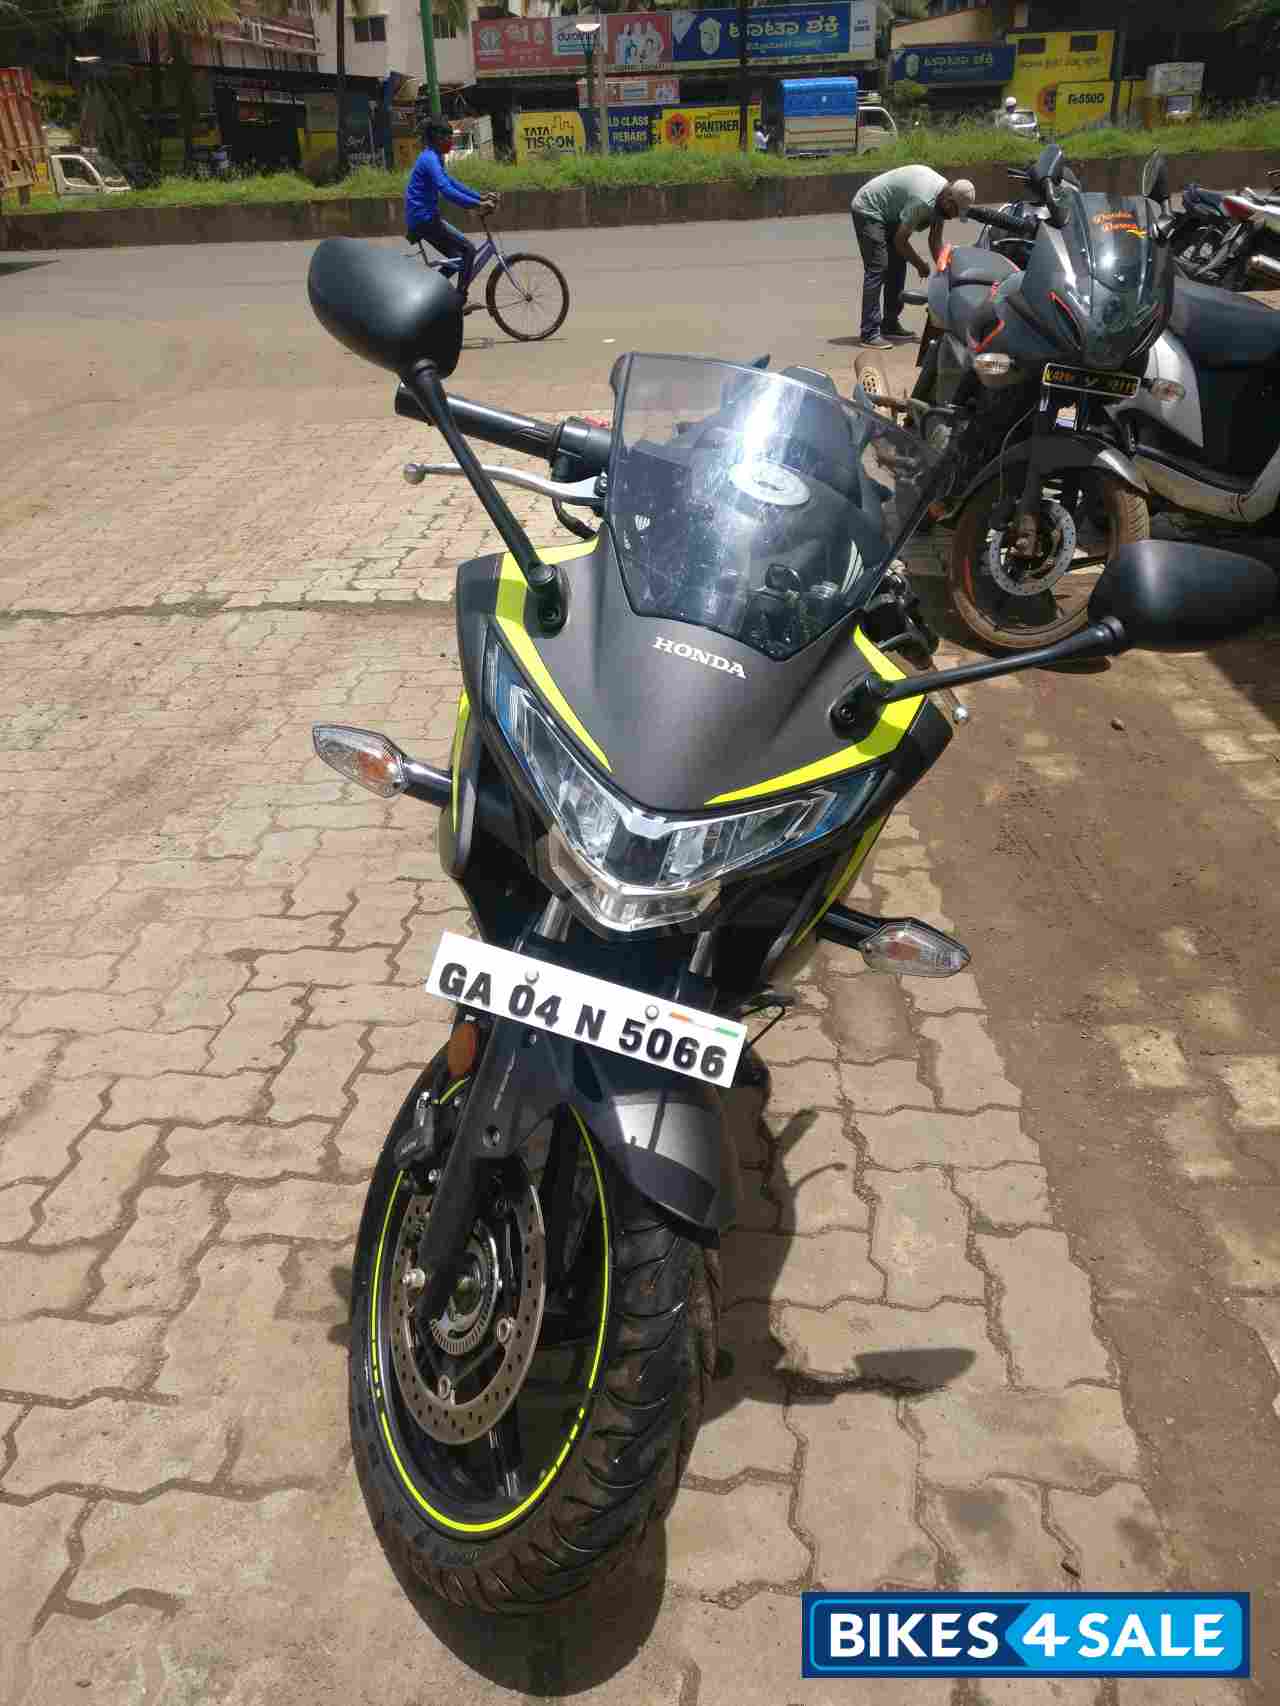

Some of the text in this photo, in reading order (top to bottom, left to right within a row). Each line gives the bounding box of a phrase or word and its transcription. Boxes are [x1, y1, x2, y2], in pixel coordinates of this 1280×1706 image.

[523, 127, 551, 137] TATA
[652, 636, 747, 679] HONDA
[438, 962, 728, 1079] GA 04 N 5066
